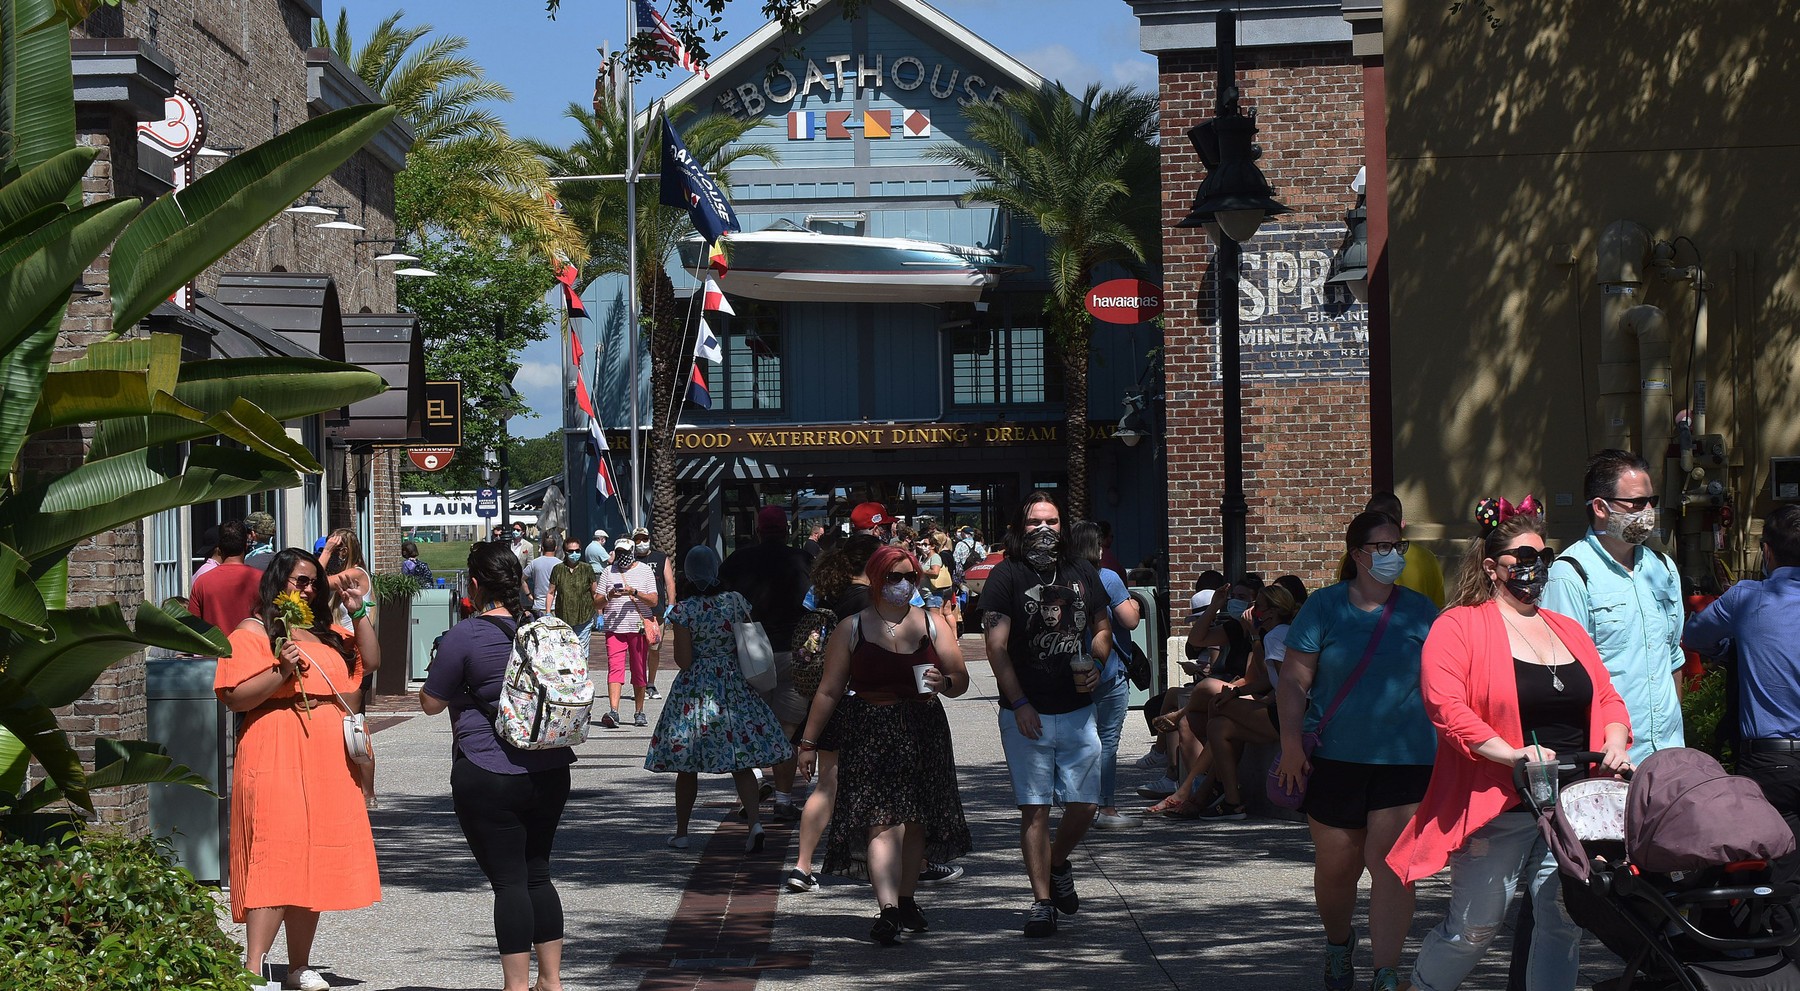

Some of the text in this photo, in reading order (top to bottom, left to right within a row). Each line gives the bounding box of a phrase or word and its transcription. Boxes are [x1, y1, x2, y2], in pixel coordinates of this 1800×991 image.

[1092, 294, 1159, 309] havaianas
[1239, 326, 1344, 346] MINERAL
[1270, 350, 1314, 358] CLEAR
[675, 433, 732, 449] FOOD
[747, 429, 884, 447] WATERFRONT
[891, 428, 968, 445] DINING
[985, 427, 1057, 442] DREAM
